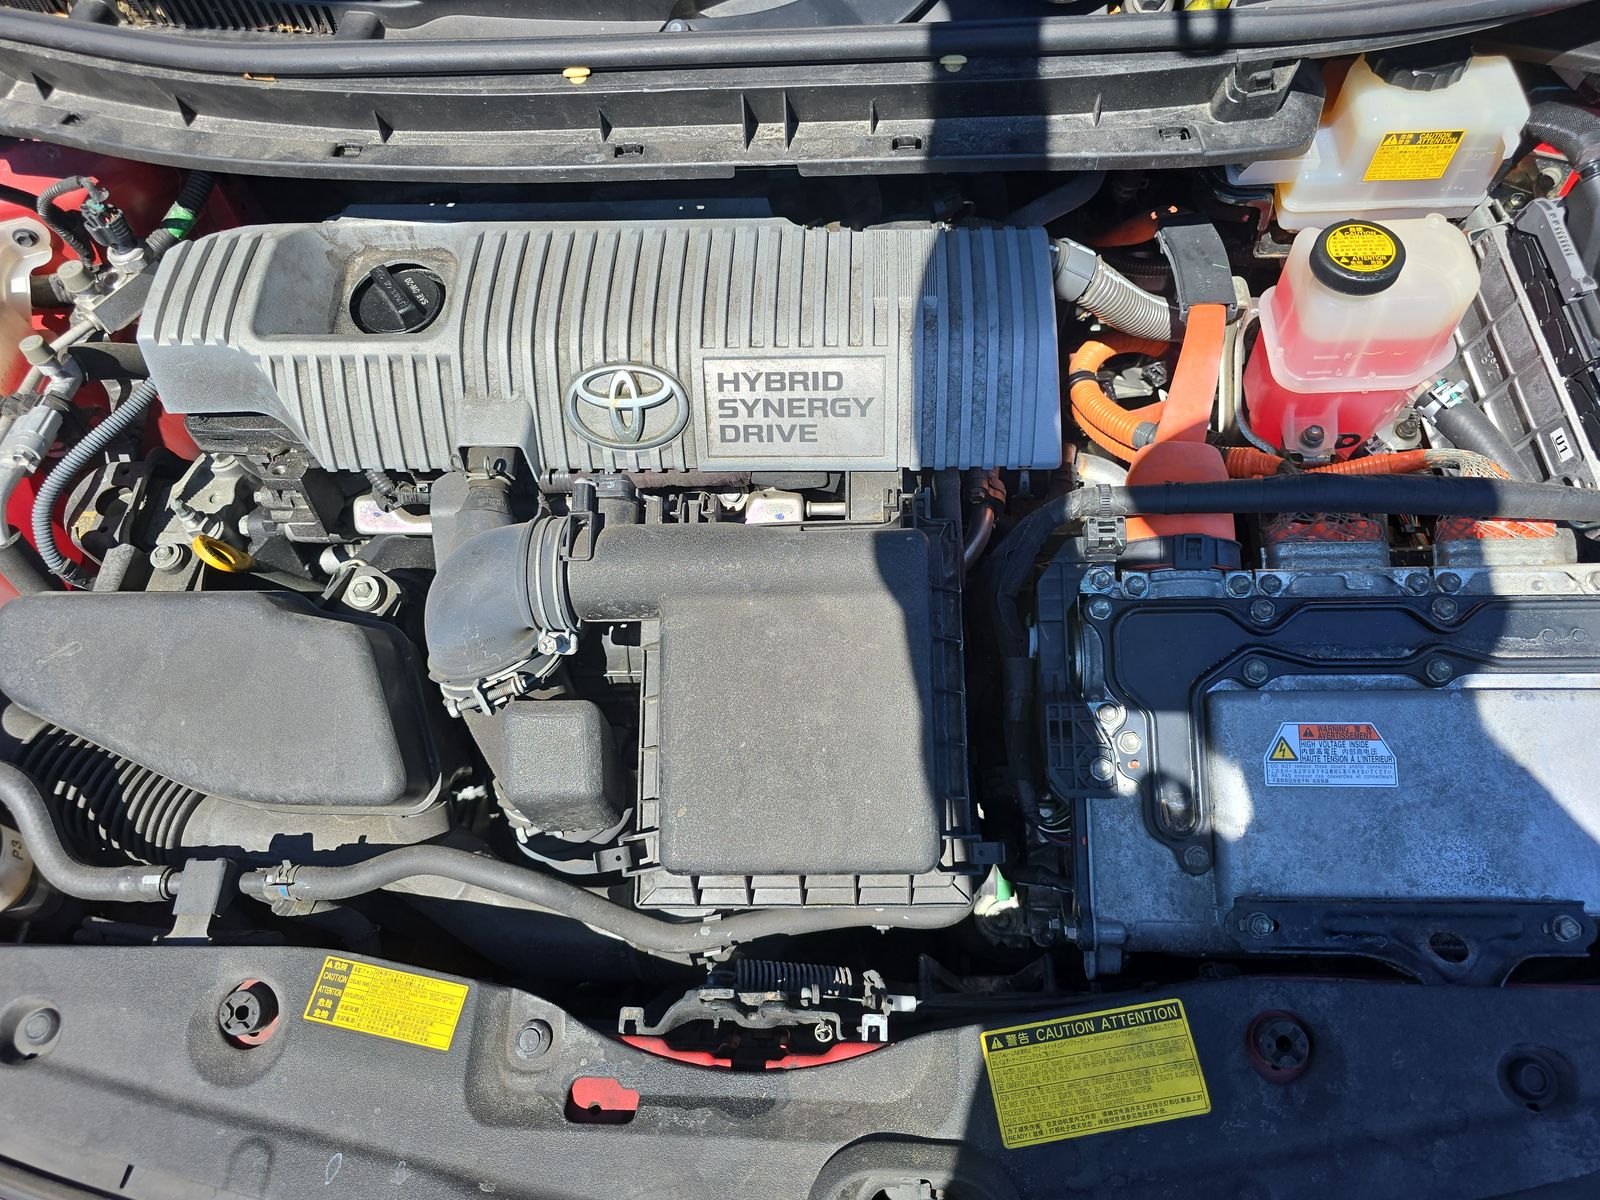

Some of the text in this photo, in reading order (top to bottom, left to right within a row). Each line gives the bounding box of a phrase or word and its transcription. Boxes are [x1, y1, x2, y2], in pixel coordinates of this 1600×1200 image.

[1416, 137, 1458, 145] ATTENTION
[404, 277, 429, 306] SAE 0W-20
[717, 371, 844, 392] HYBRID
[718, 397, 875, 418] SYNERGY
[719, 424, 818, 443] DRIVE
[1555, 434, 1569, 454] U1
[1301, 740, 1369, 749] HIGH VOLTAGE INSIDE
[1318, 732, 1373, 740] AVERTISSEMENT
[1301, 755, 1321, 763] HAUTE
[1323, 755, 1346, 763] TENSION
[11, 840, 24, 860] P3
[323, 971, 349, 984] CAUTION
[318, 985, 344, 998] ATTENTION
[1004, 1032, 1031, 1047] 警告
[1034, 1021, 1095, 1042] CAUTION
[1099, 1006, 1178, 1030] ATTENTION
